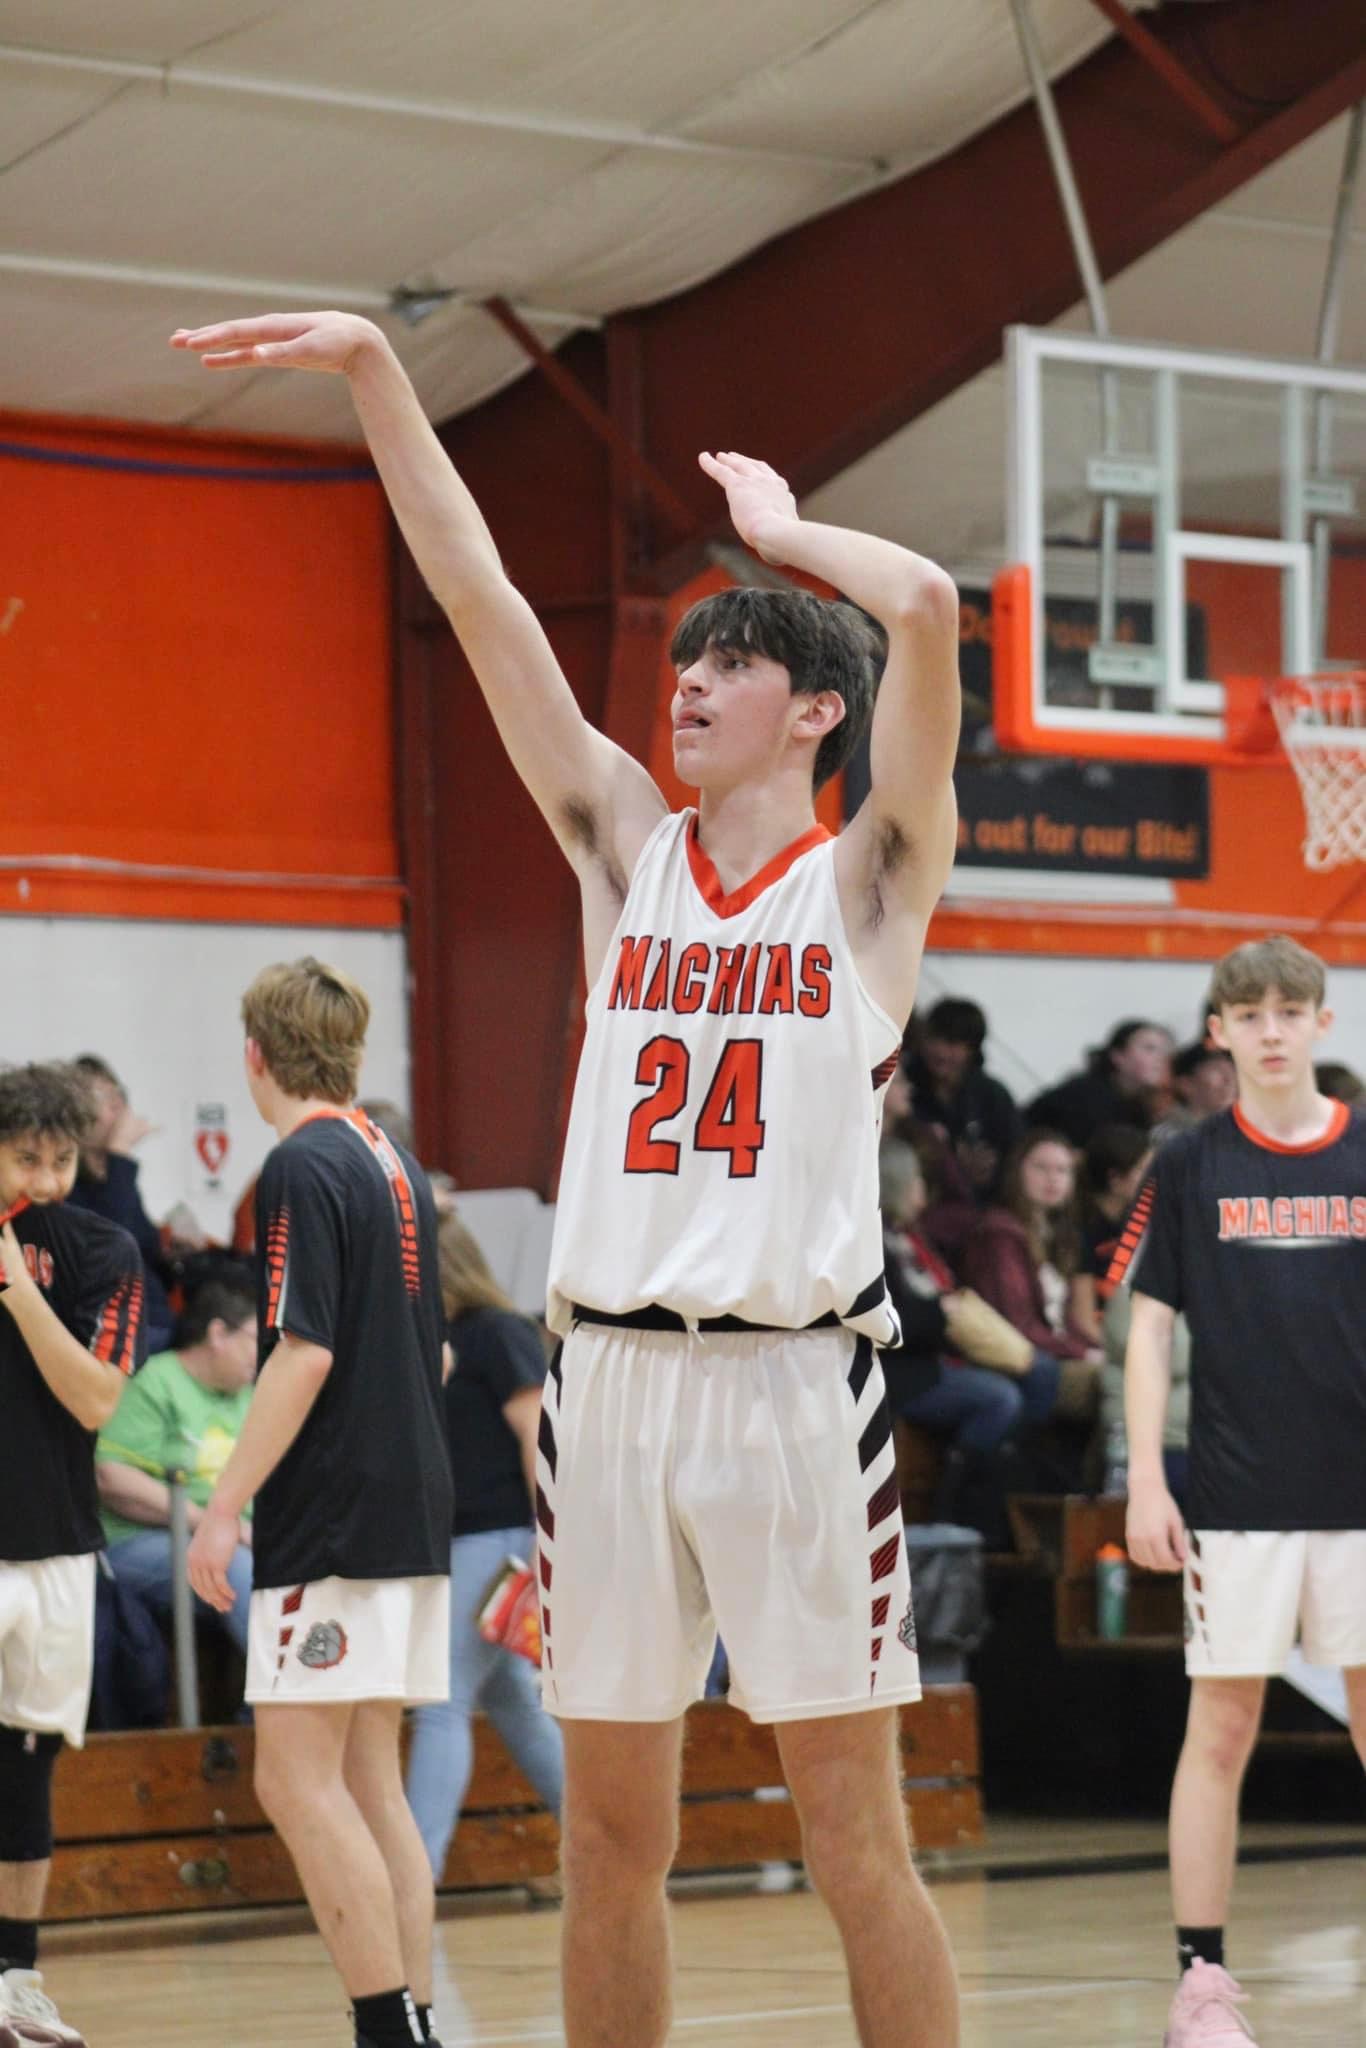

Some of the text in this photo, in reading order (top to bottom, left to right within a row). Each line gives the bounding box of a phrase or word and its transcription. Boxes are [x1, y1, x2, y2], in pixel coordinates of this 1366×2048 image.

[974, 816, 1027, 851] out
[1033, 813, 1077, 853] for
[1081, 825, 1131, 857] our
[607, 935, 832, 1018] MACHIAS
[623, 1034, 765, 1178] 24
[1217, 1195, 1366, 1241] MACHIAS
